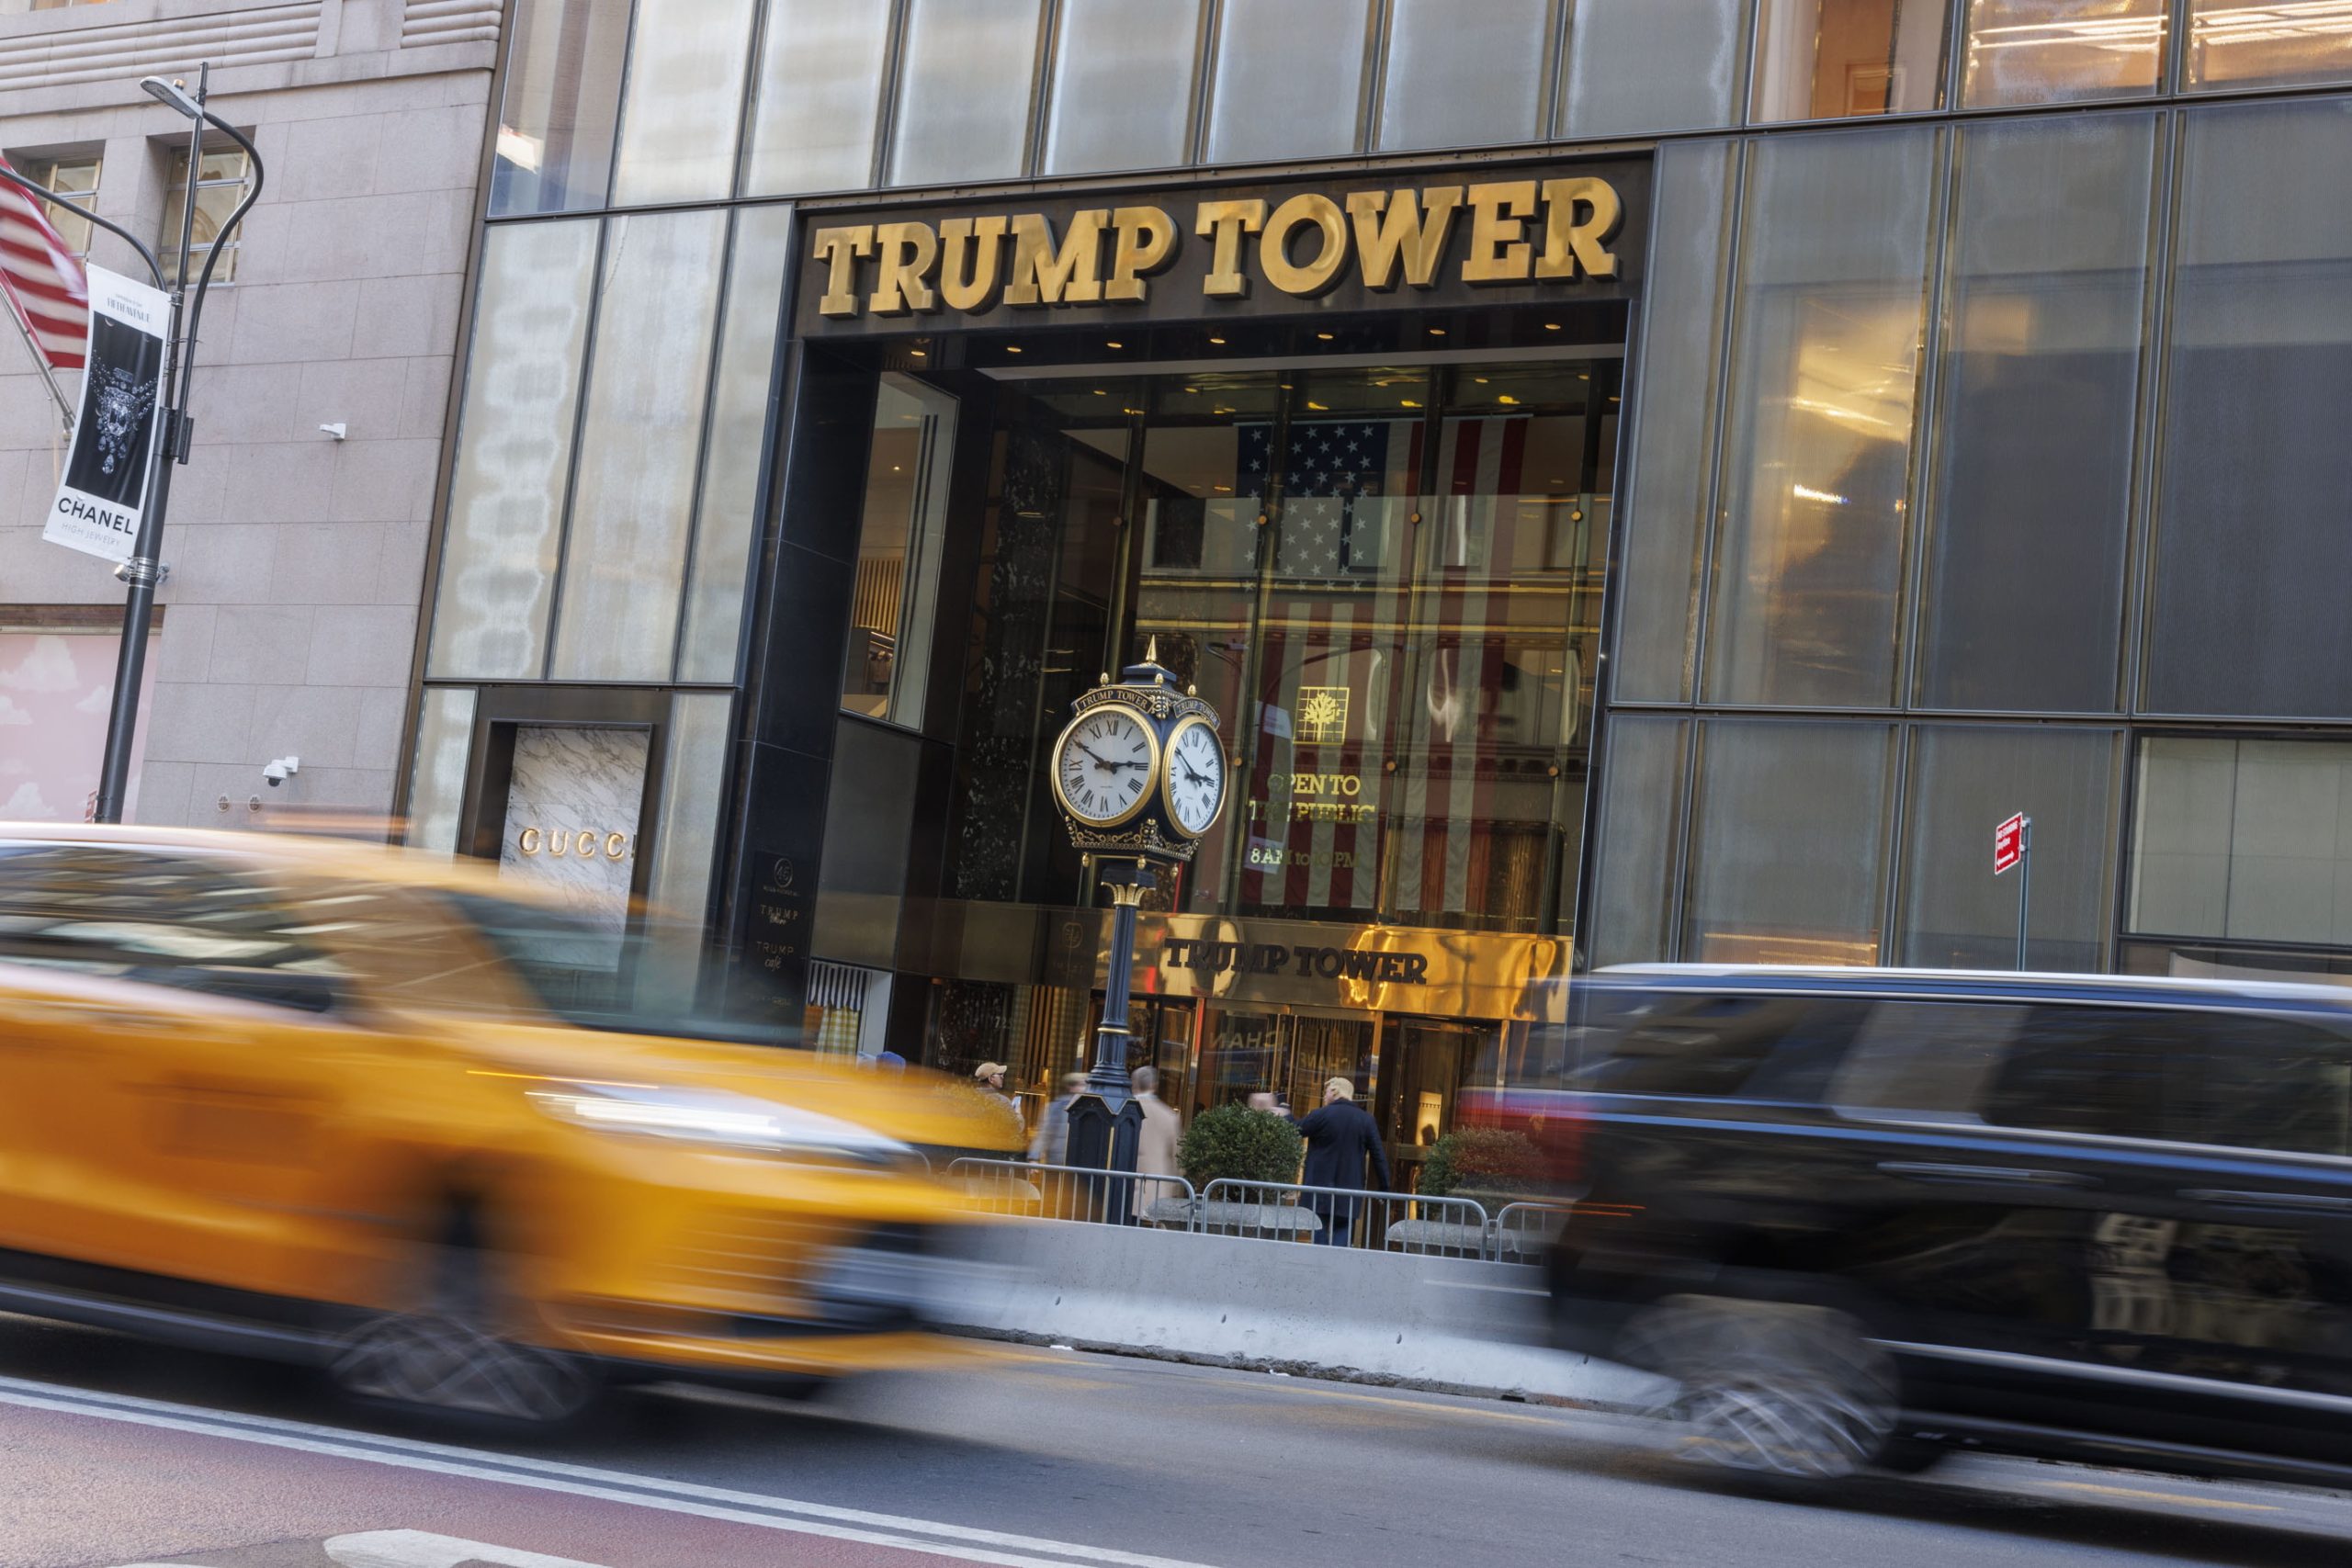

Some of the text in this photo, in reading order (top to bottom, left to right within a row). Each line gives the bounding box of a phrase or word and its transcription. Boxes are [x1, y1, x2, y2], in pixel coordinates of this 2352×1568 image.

[813, 176, 1622, 318] TRUMP TOWER
[58, 497, 134, 536] CHANEL
[61, 522, 121, 547] HIGH JEWELRY
[1080, 689, 1148, 709] TRUMP TOWER
[1176, 701, 1218, 725] TRUMP TOWER
[1267, 773, 1361, 795] OPEN TO
[1295, 802, 1375, 824] PUBLIC
[1251, 849, 1260, 863] 8
[1261, 849, 1294, 865] AM
[1295, 852, 1309, 866] to
[1333, 852, 1361, 868] PM
[760, 904, 798, 920] TRUMP
[756, 941, 794, 955] TRUMP
[1164, 937, 1429, 986] TRUMP TOWER
